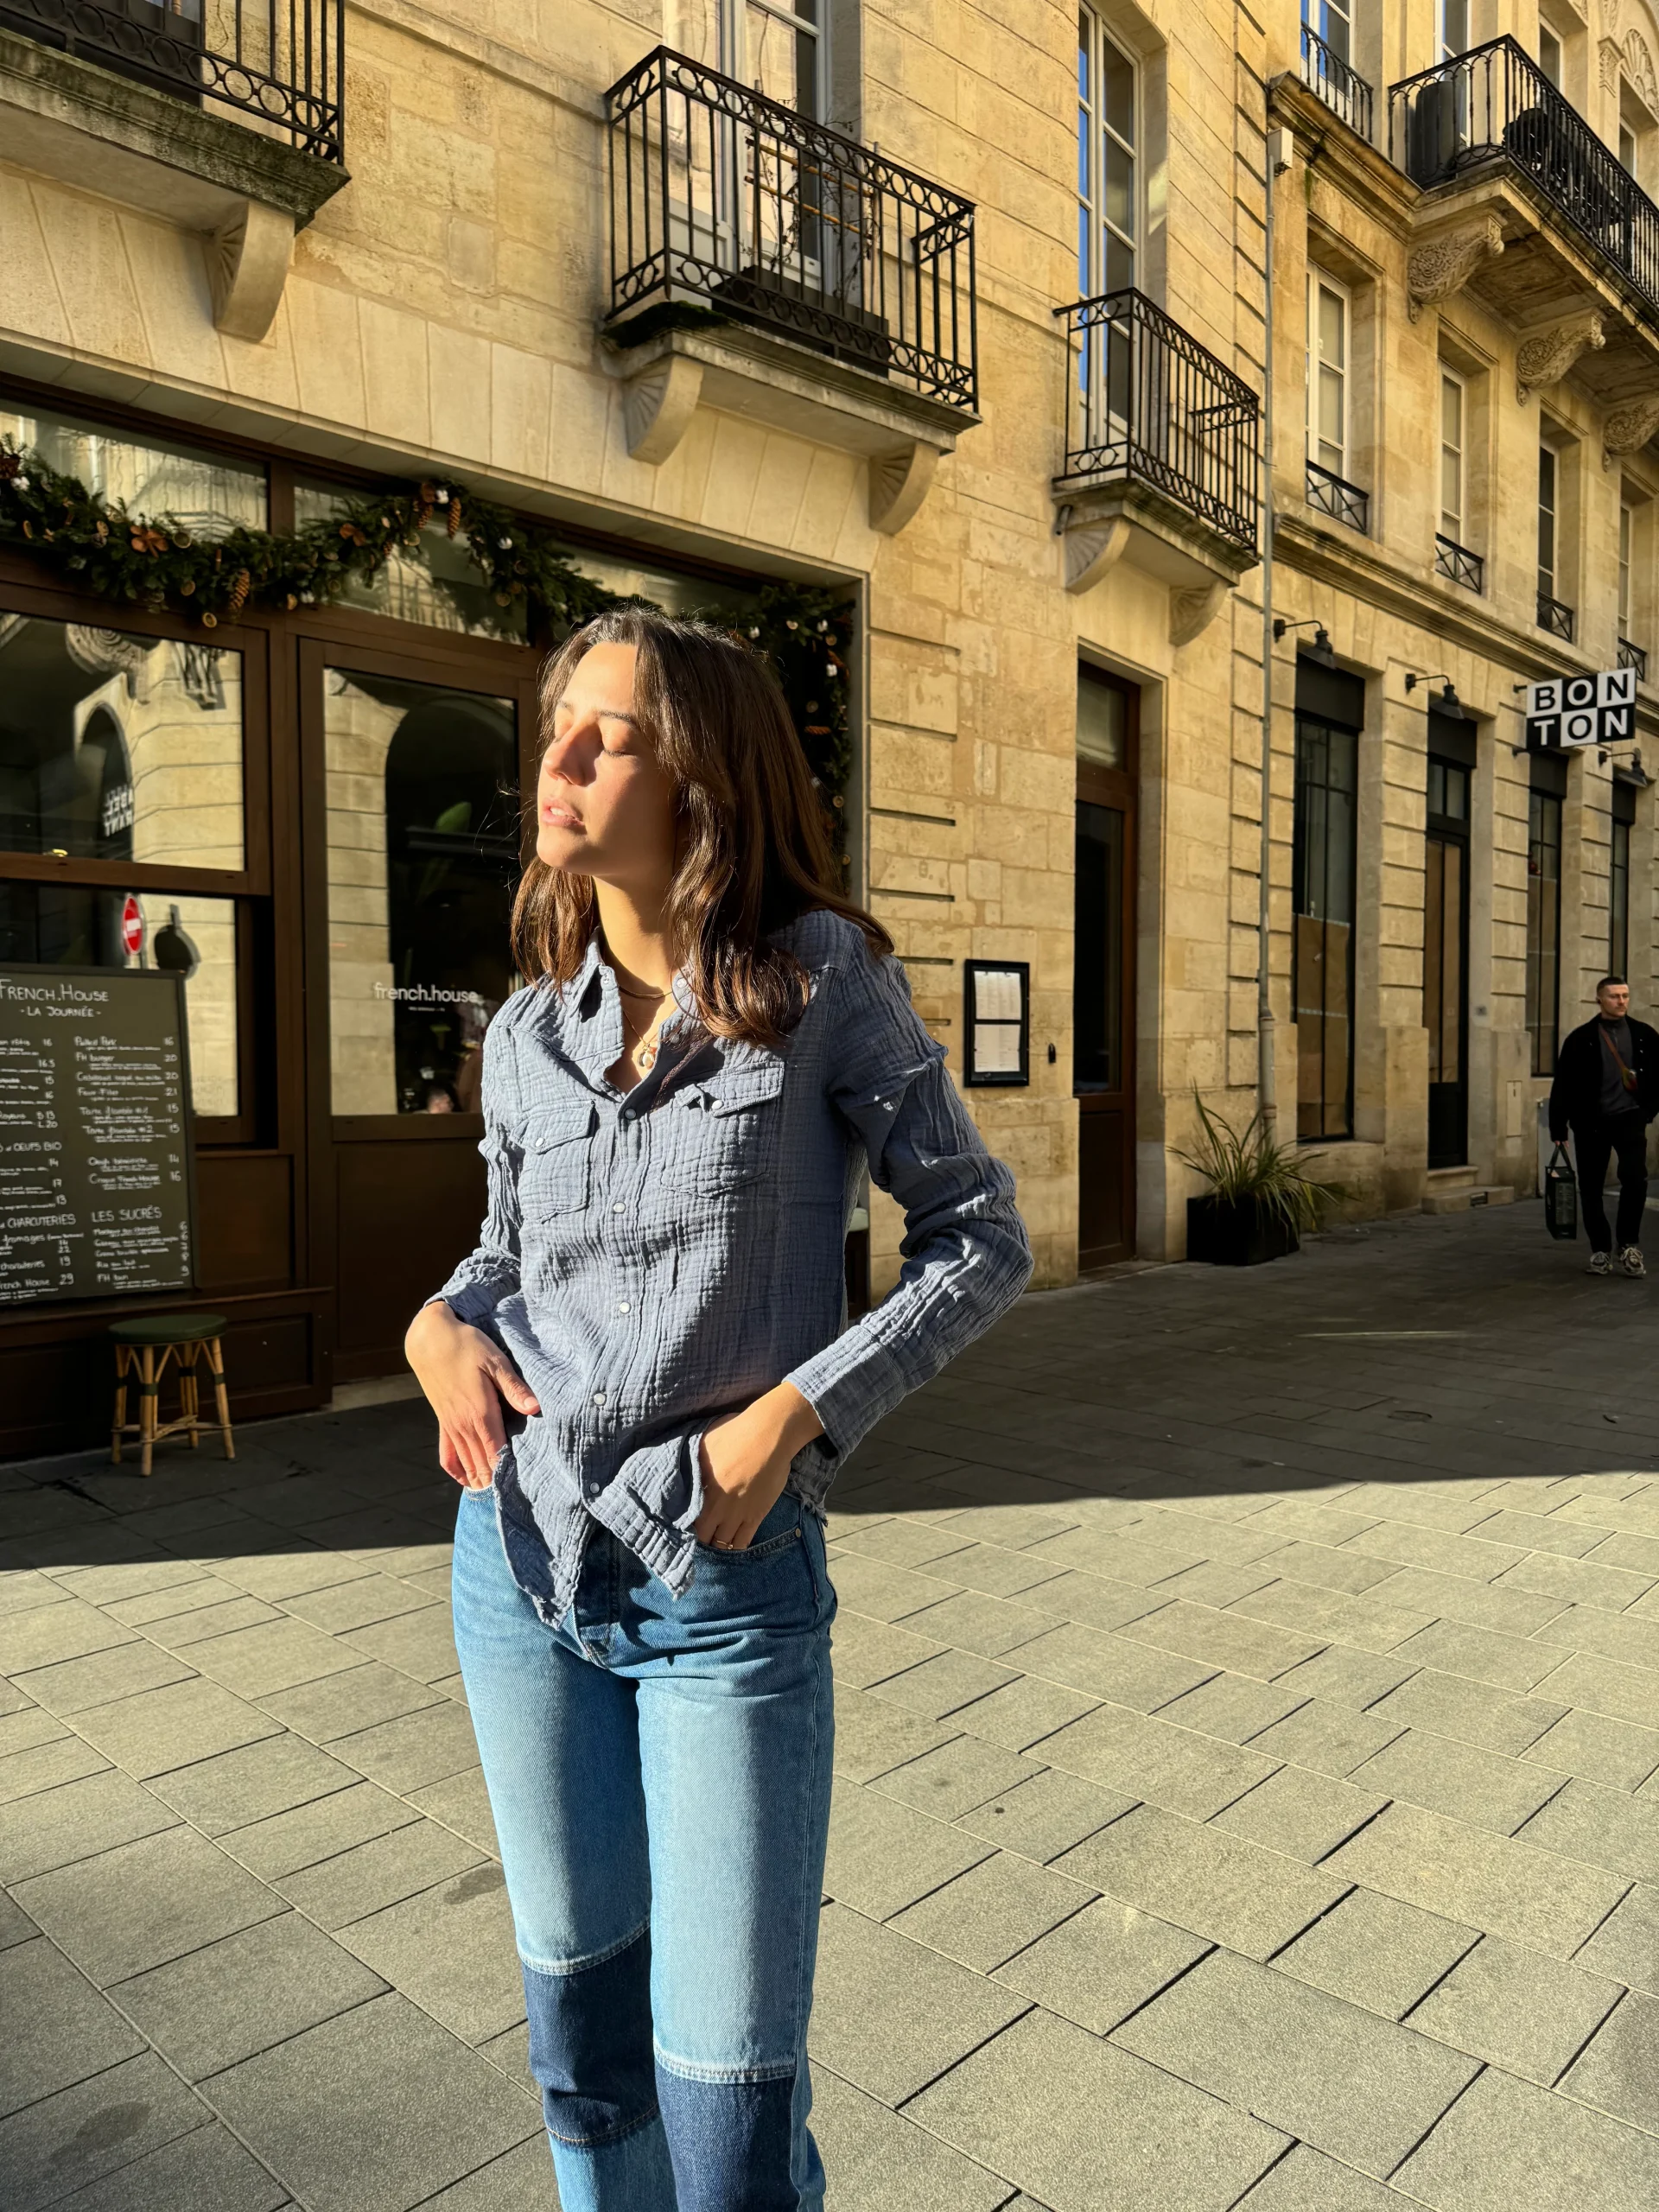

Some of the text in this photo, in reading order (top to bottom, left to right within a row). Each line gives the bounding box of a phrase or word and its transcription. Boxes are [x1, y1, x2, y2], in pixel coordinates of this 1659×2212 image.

[1535, 673, 1629, 712] BON
[1534, 708, 1628, 747] TON
[373, 982, 480, 1003] french.house
[92, 1205, 162, 1223] LES SUCRÉS
[60, 1273, 73, 1285] 29
